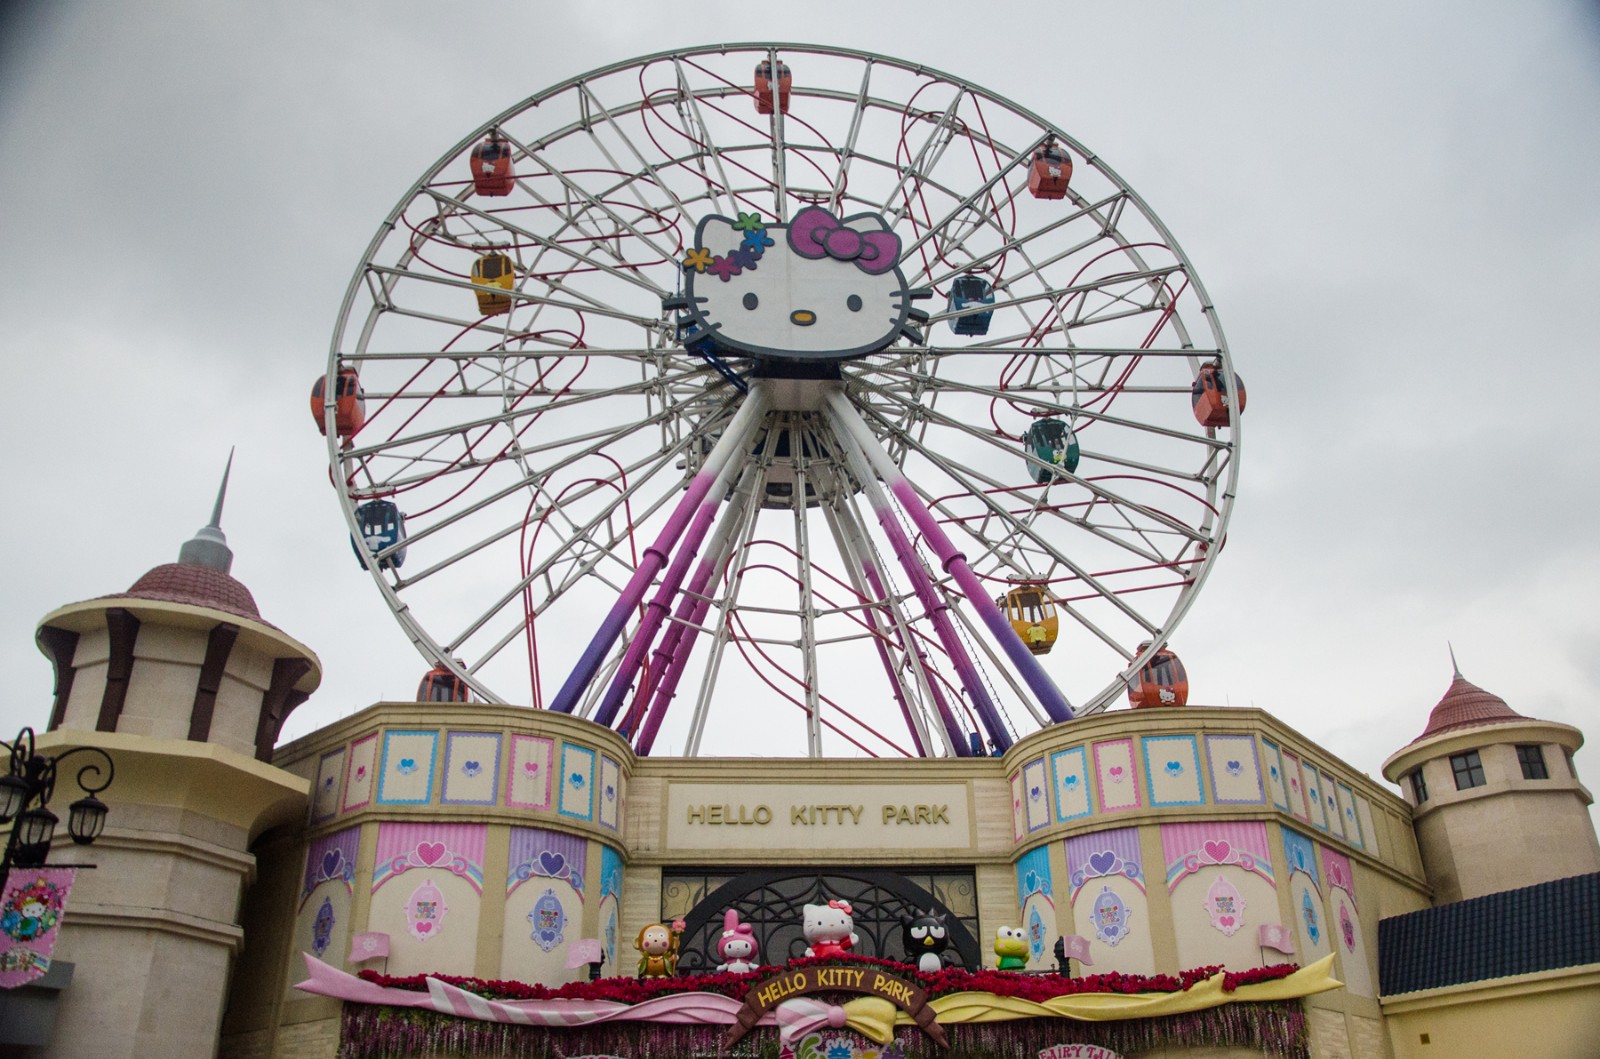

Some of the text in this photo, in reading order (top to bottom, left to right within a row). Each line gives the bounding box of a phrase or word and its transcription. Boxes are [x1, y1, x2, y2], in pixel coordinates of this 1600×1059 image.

[687, 804, 950, 826] HELLO KITTY PARK
[757, 969, 914, 1008] HELLO KITTY PARK
